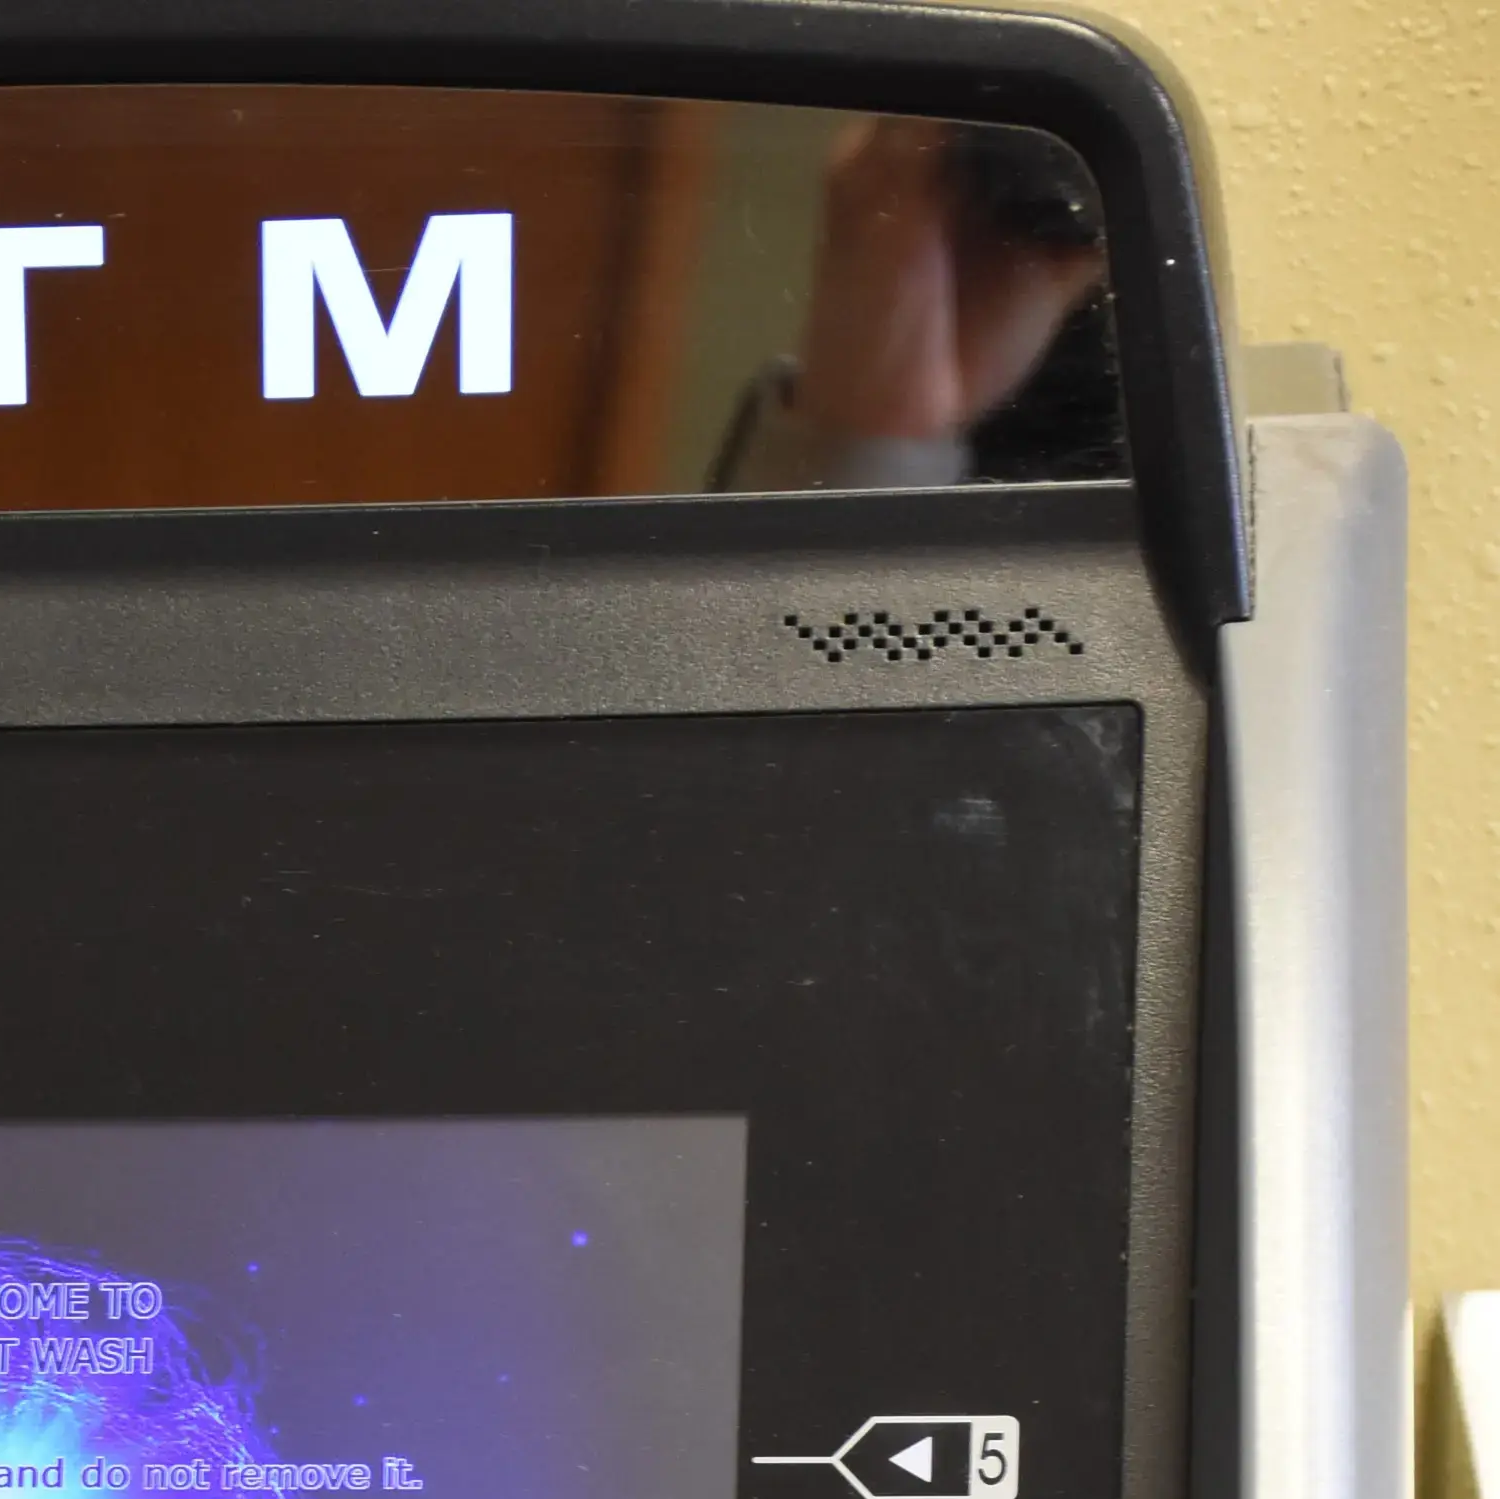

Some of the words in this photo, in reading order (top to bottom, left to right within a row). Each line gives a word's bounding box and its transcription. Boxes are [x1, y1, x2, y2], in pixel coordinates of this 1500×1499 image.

[98, 1282, 163, 1320] TO
[29, 1337, 154, 1375] WASH
[81, 1457, 130, 1490] do
[143, 1458, 210, 1490] not
[221, 1462, 372, 1490] remove
[382, 1456, 424, 1490] it.
[978, 1432, 1007, 1485] 5
